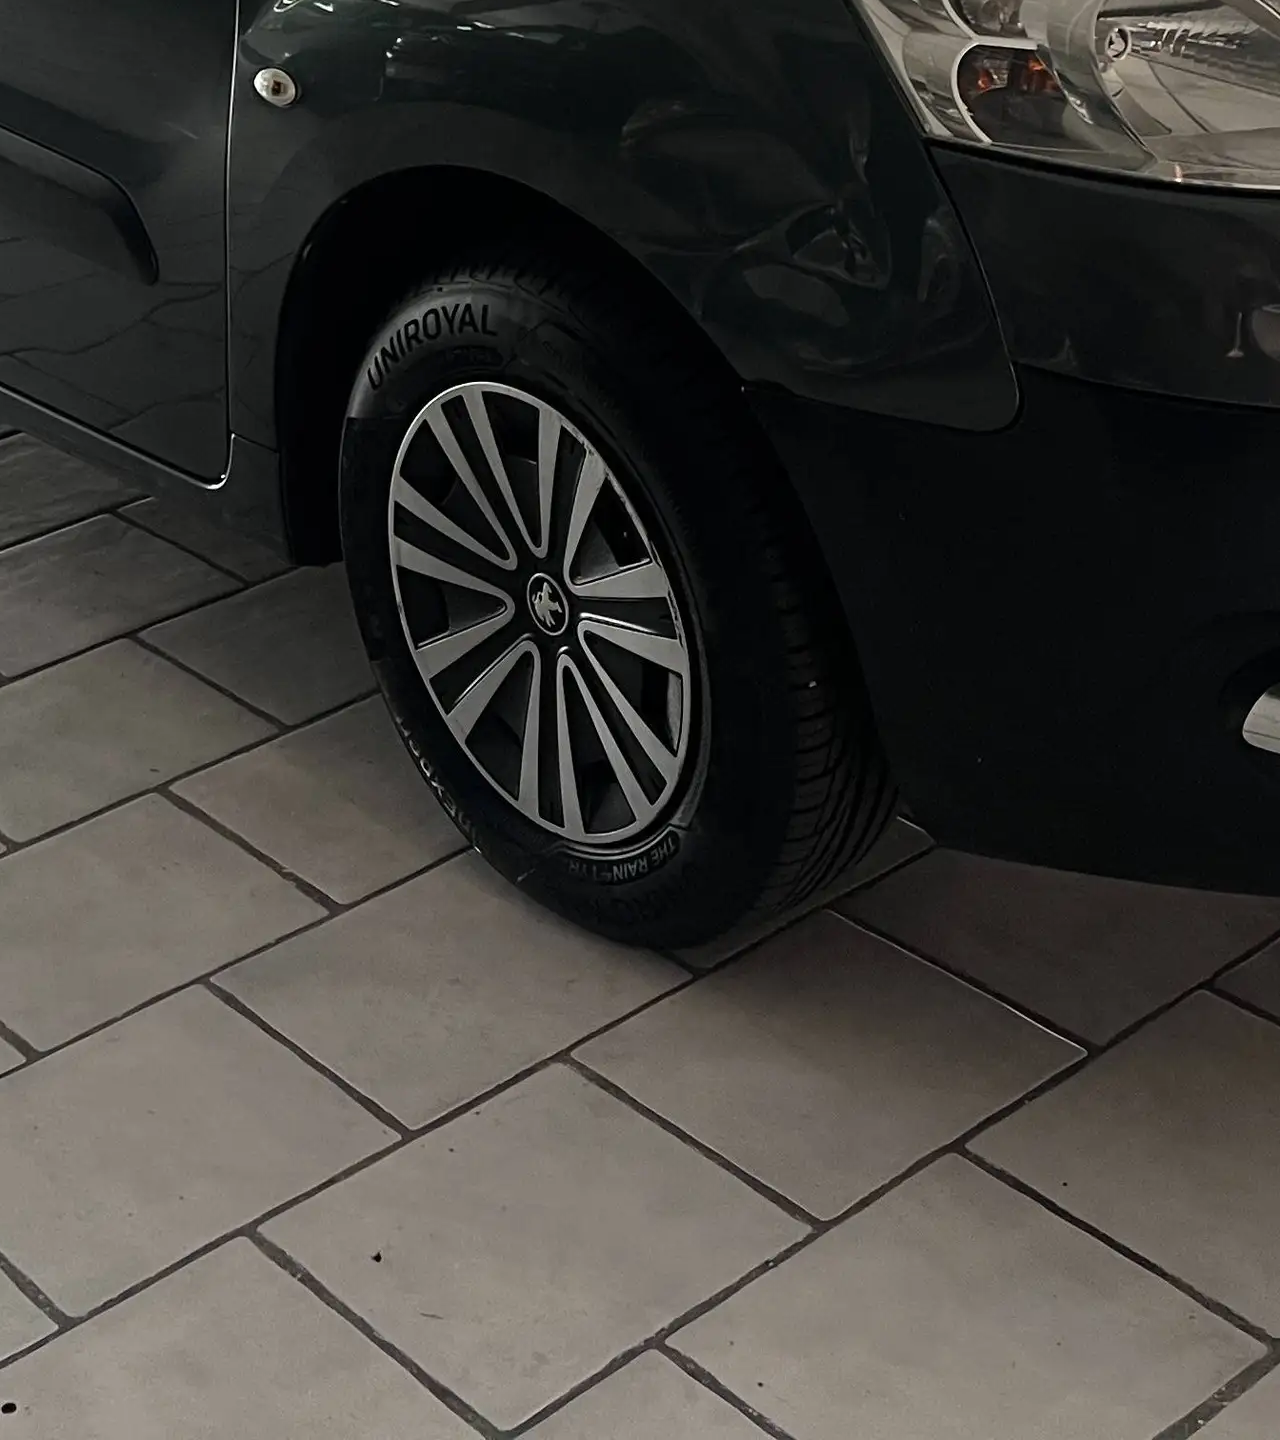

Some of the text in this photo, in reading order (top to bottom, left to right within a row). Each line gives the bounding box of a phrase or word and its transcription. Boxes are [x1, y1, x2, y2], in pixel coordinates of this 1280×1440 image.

[366, 302, 499, 391] UNIROYAL
[650, 835, 677, 865] THE
[612, 858, 650, 883] RAIN
